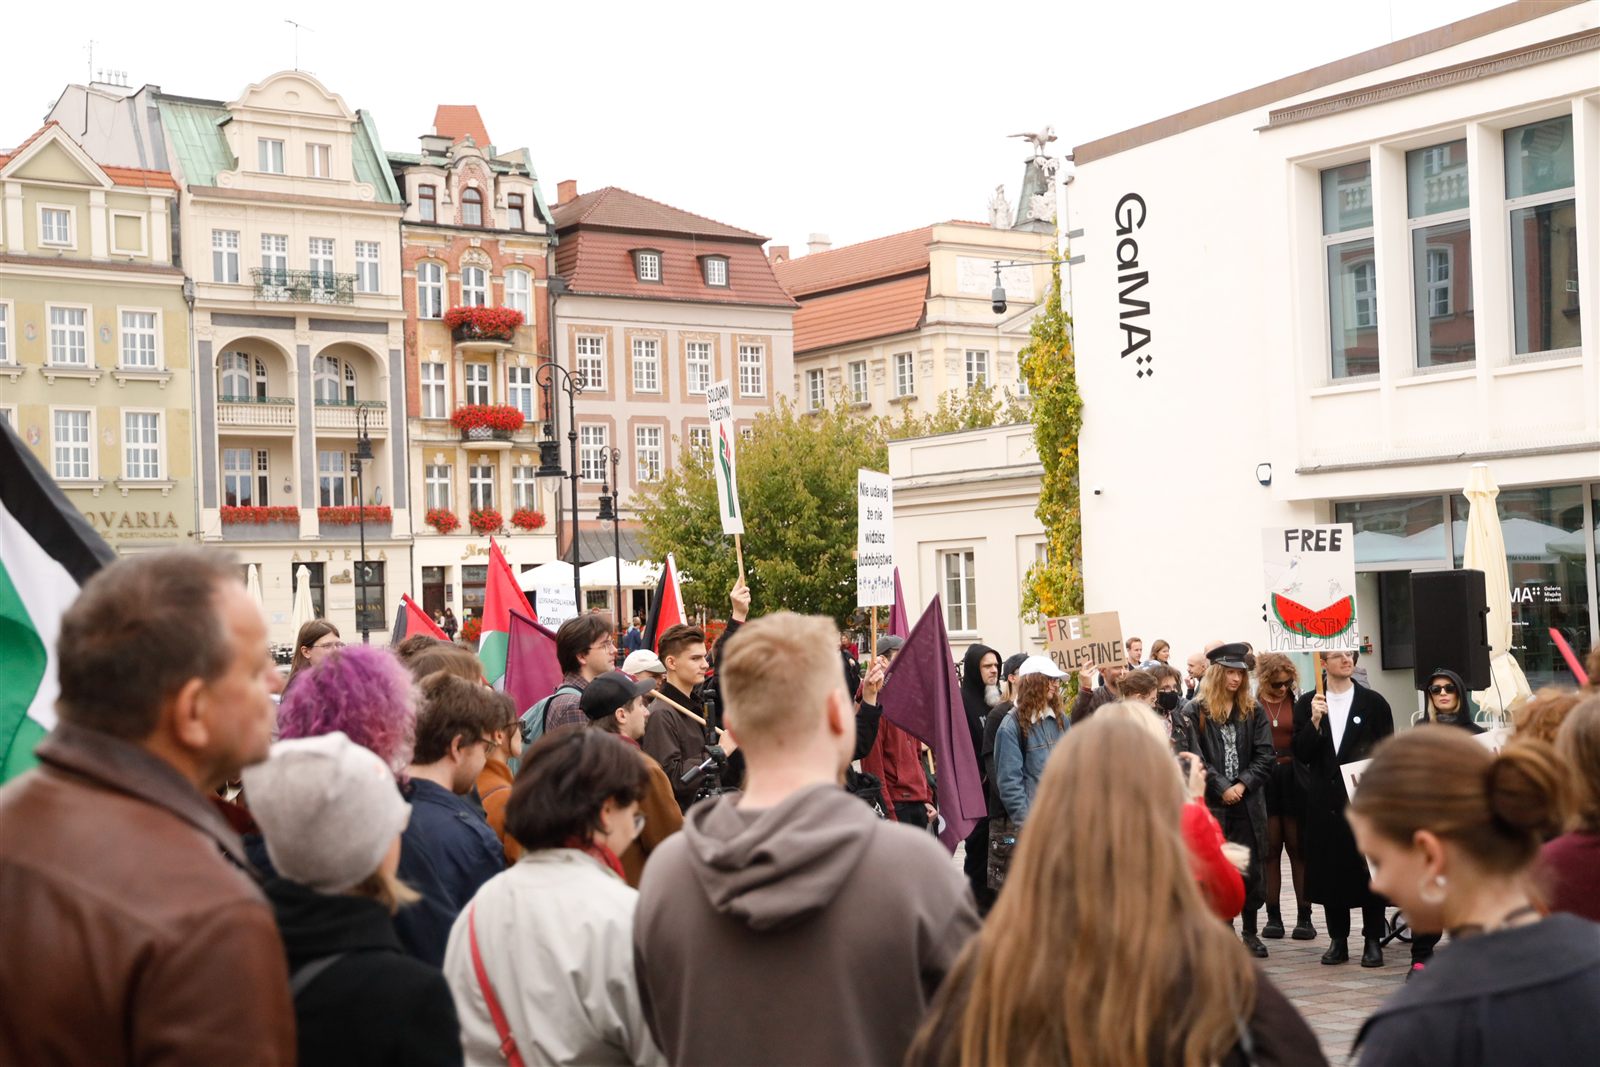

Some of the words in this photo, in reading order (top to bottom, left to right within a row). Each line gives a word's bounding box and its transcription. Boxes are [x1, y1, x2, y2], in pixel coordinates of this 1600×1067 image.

[1115, 192, 1151, 359] GaMA
[860, 482, 869, 496] Nie
[870, 485, 888, 502] udawaj
[874, 507, 882, 520] nie
[865, 530, 885, 544] widzisz
[1285, 529, 1342, 552] FREE
[291, 549, 388, 561] APTEKA
[859, 552, 892, 568] ludobójstwa
[1046, 616, 1092, 641] FREE
[1268, 618, 1359, 651] PALESTINE
[1050, 641, 1123, 670] PALESTINE
